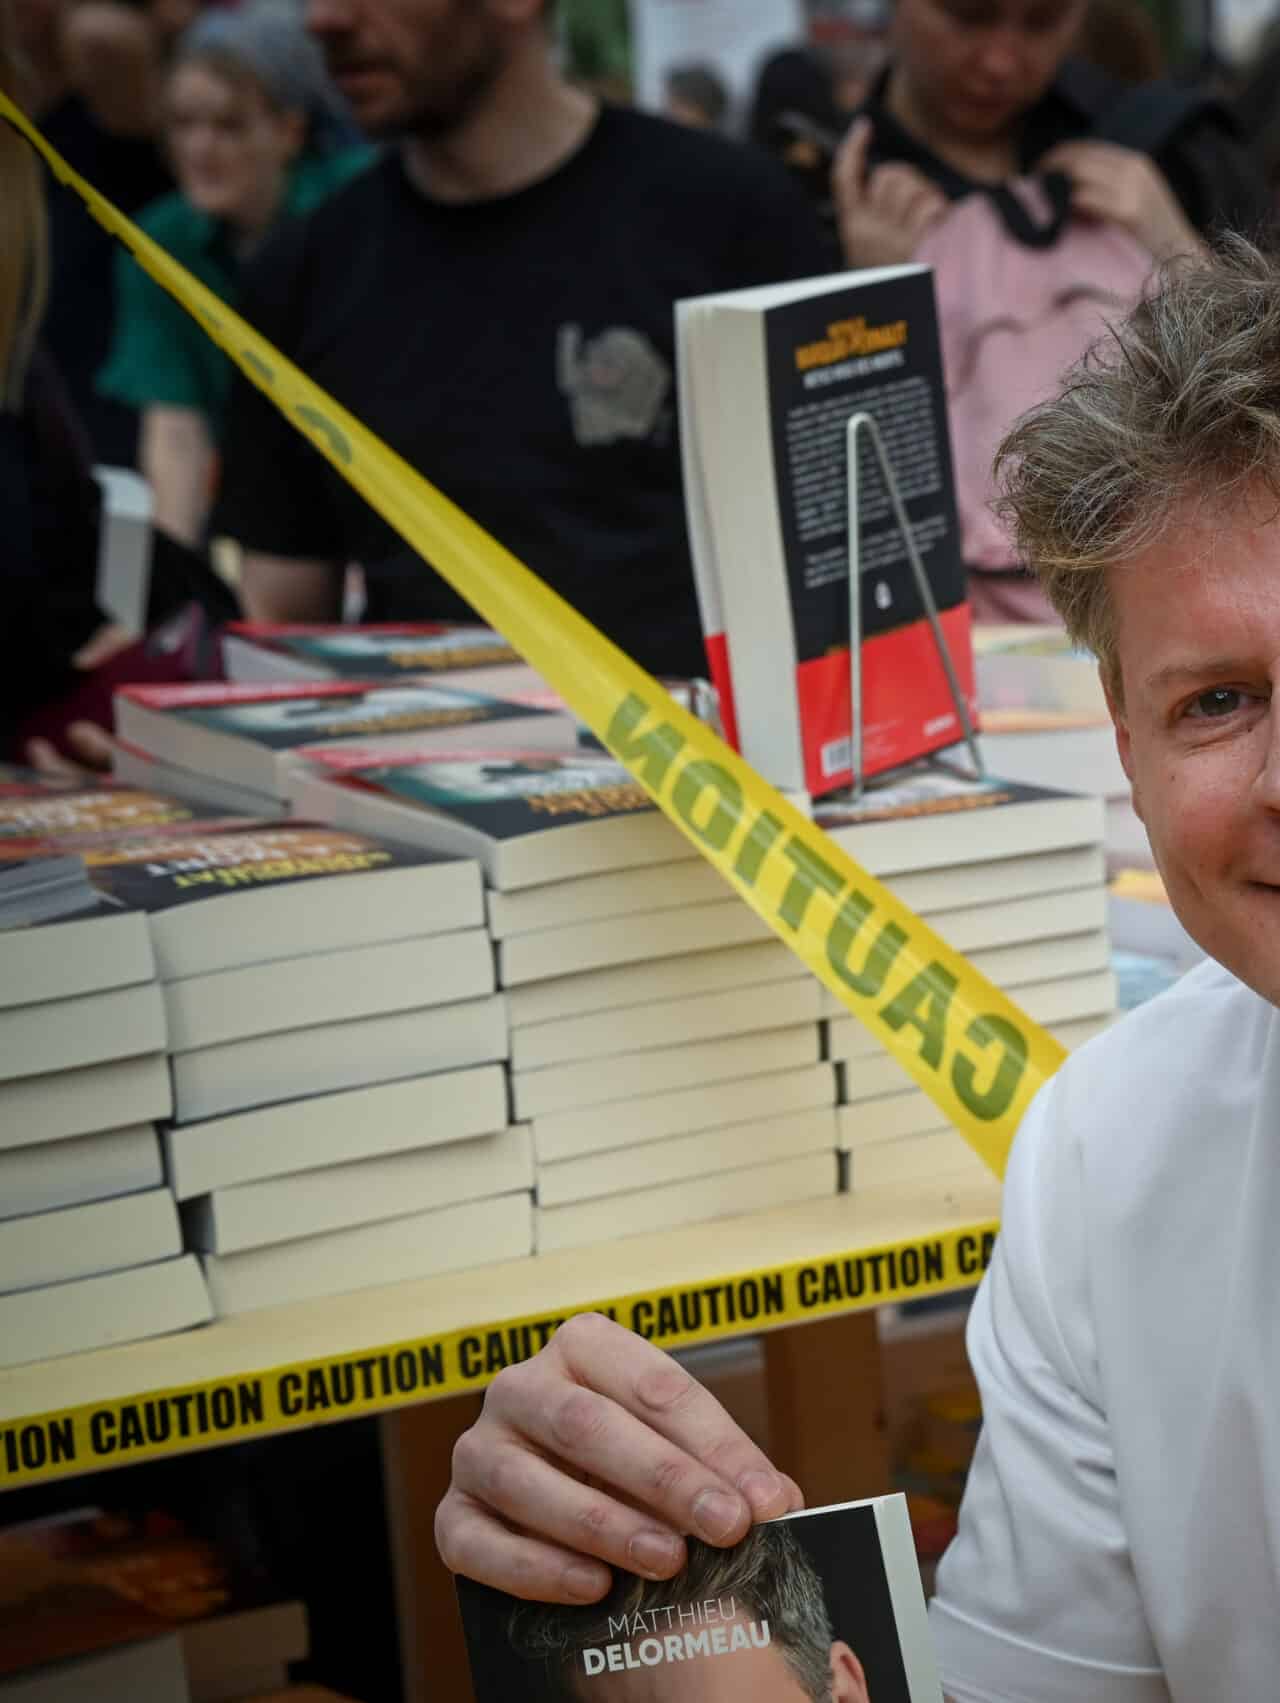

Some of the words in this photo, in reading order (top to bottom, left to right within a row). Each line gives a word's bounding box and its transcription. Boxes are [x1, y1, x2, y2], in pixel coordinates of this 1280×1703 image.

[0, 1417, 76, 1473] ION
[90, 1380, 264, 1455] CAUTION
[278, 1342, 444, 1417] CAUTION
[458, 1307, 617, 1379] CAUT
[631, 1273, 784, 1340] CAUTION
[796, 1241, 945, 1308] CAUTION
[607, 1596, 737, 1640] MATTHIEU
[583, 1620, 771, 1675] DELORMEAU
